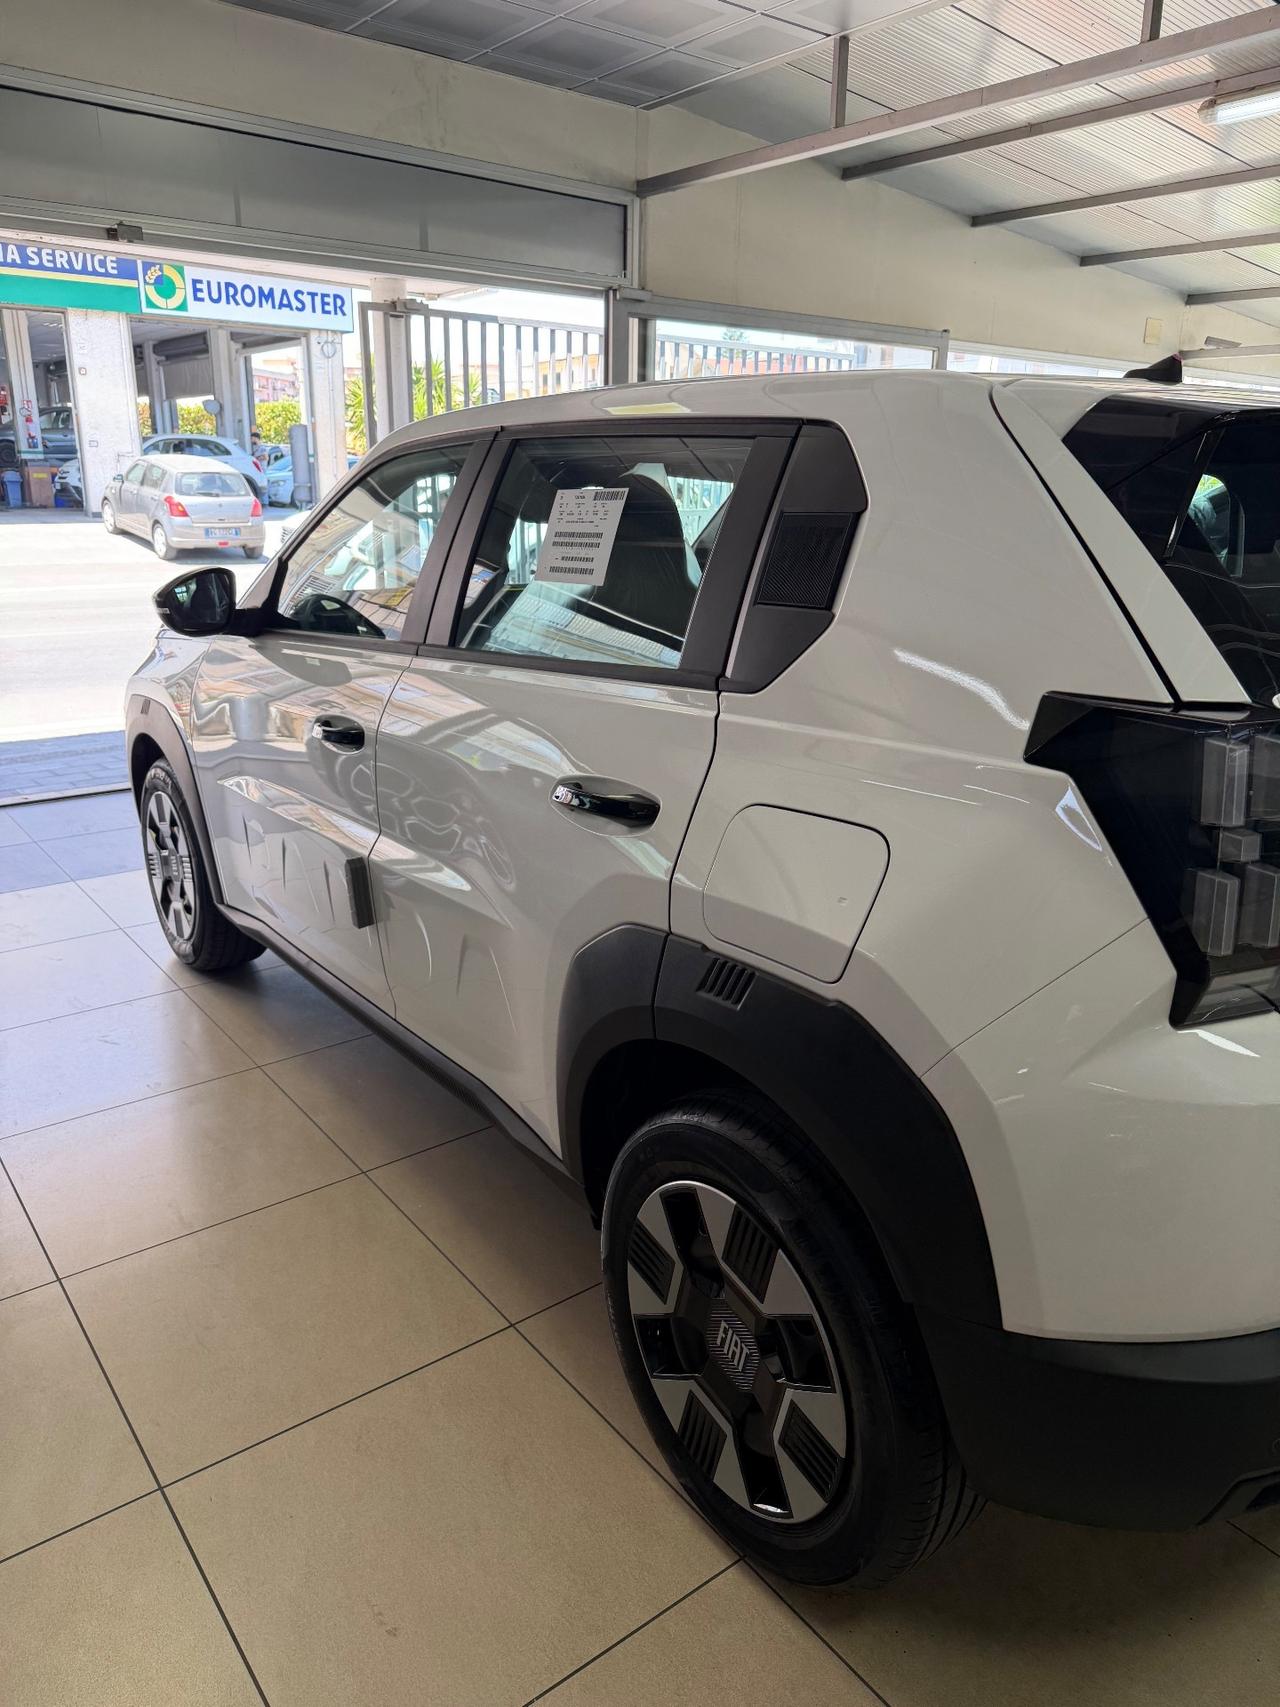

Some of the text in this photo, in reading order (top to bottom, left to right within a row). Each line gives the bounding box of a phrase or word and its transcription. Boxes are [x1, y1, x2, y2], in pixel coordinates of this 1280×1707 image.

[26, 246, 118, 275] SERVICE
[191, 277, 347, 317] EUROMASTER
[716, 1319, 750, 1373] FIAT
